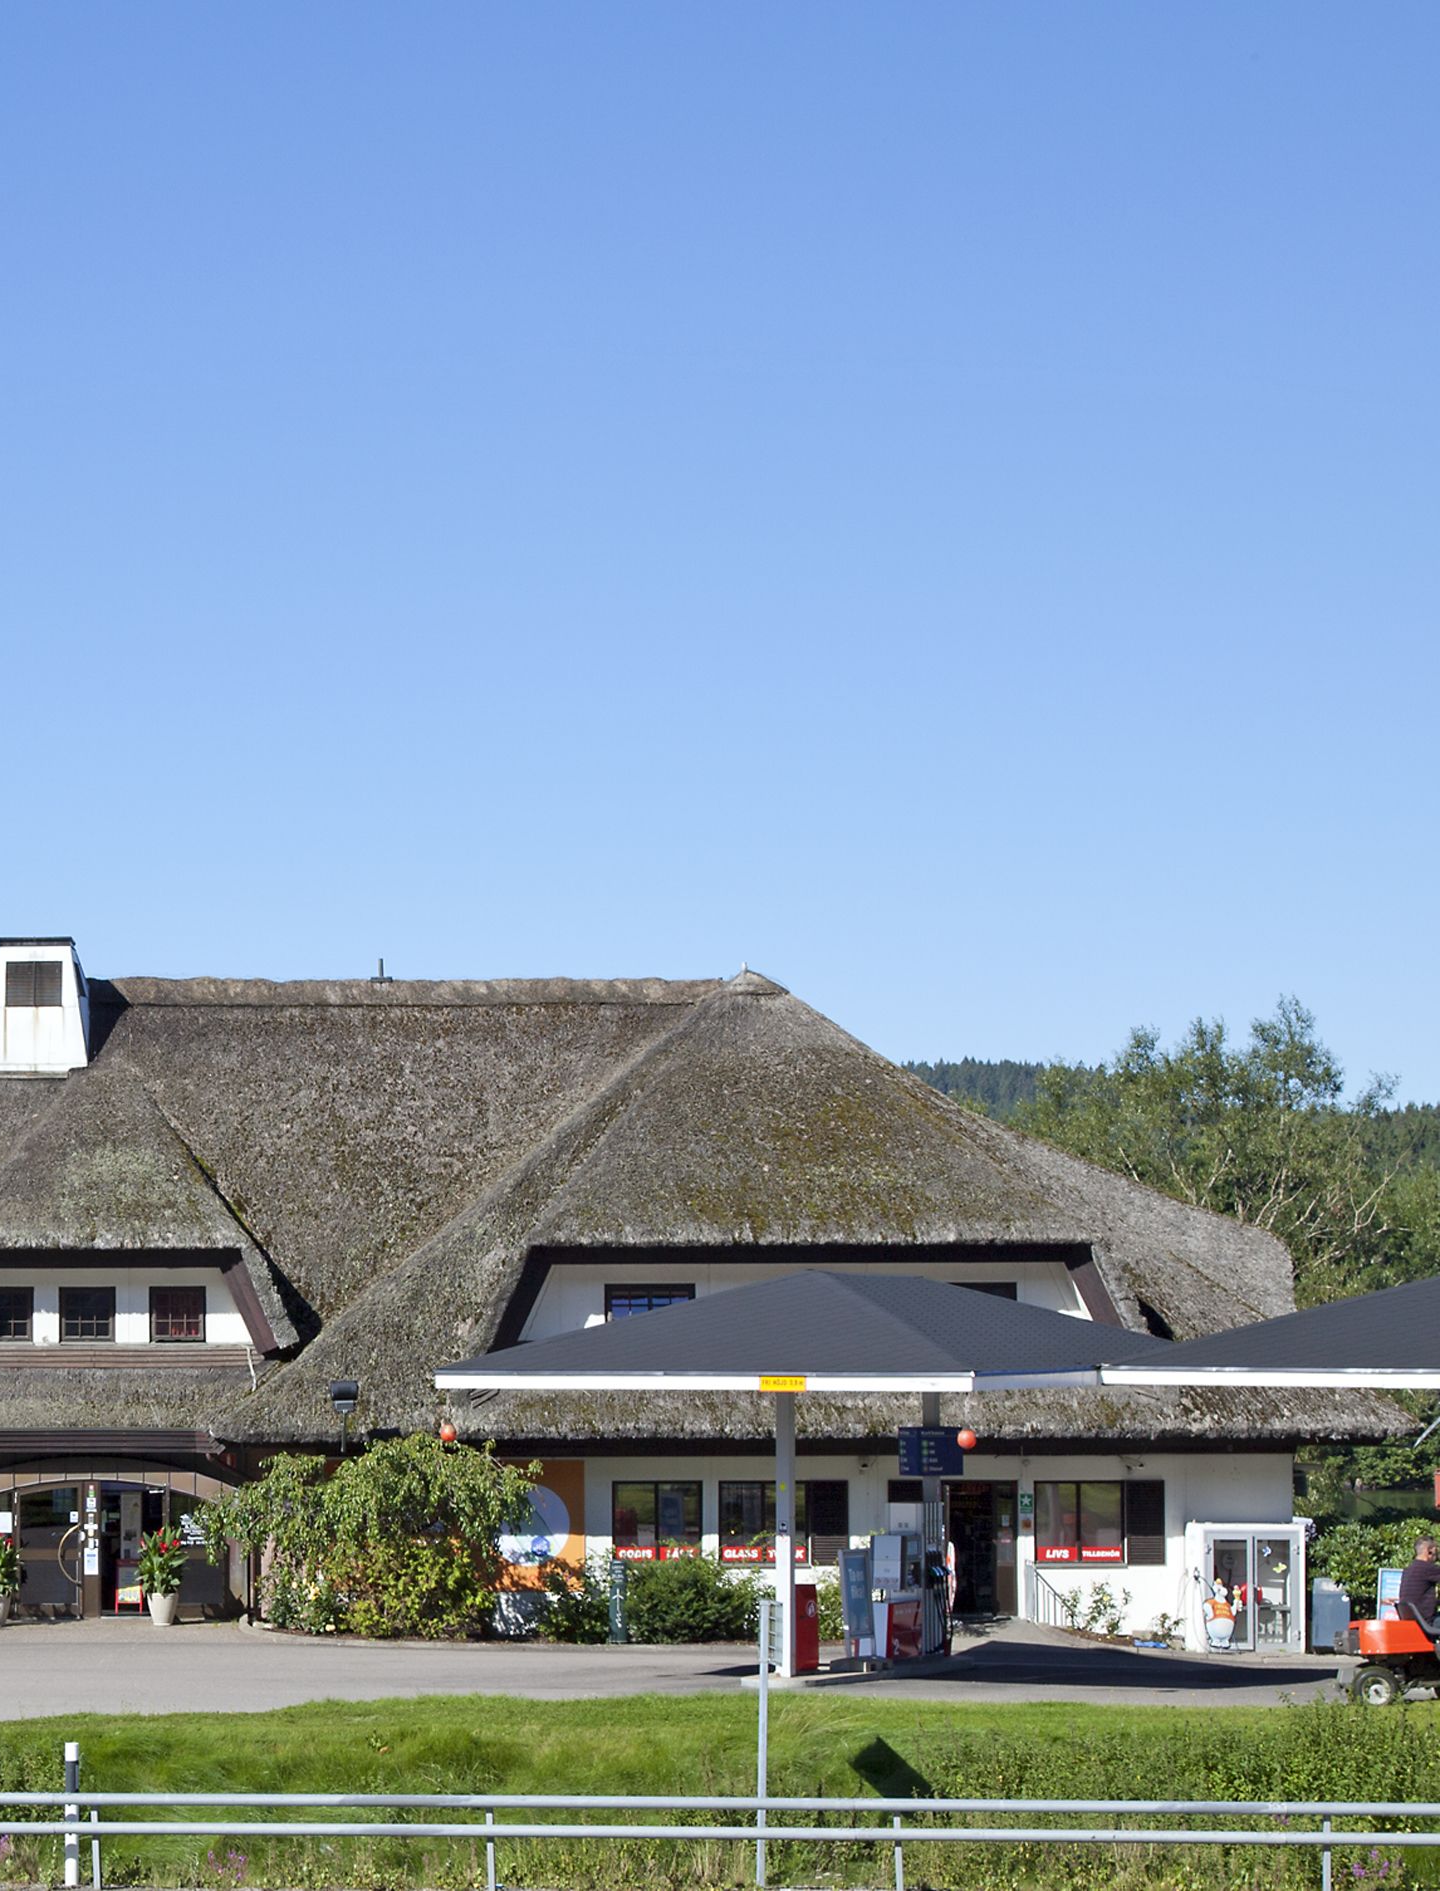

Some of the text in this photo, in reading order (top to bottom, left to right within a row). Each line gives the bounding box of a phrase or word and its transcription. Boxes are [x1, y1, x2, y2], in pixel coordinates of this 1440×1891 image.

[618, 1549, 653, 1559] GODIS
[723, 1549, 759, 1559] GLASS
[1045, 1549, 1070, 1559] LIVS
[1082, 1549, 1121, 1558] TILLBEHÖR
